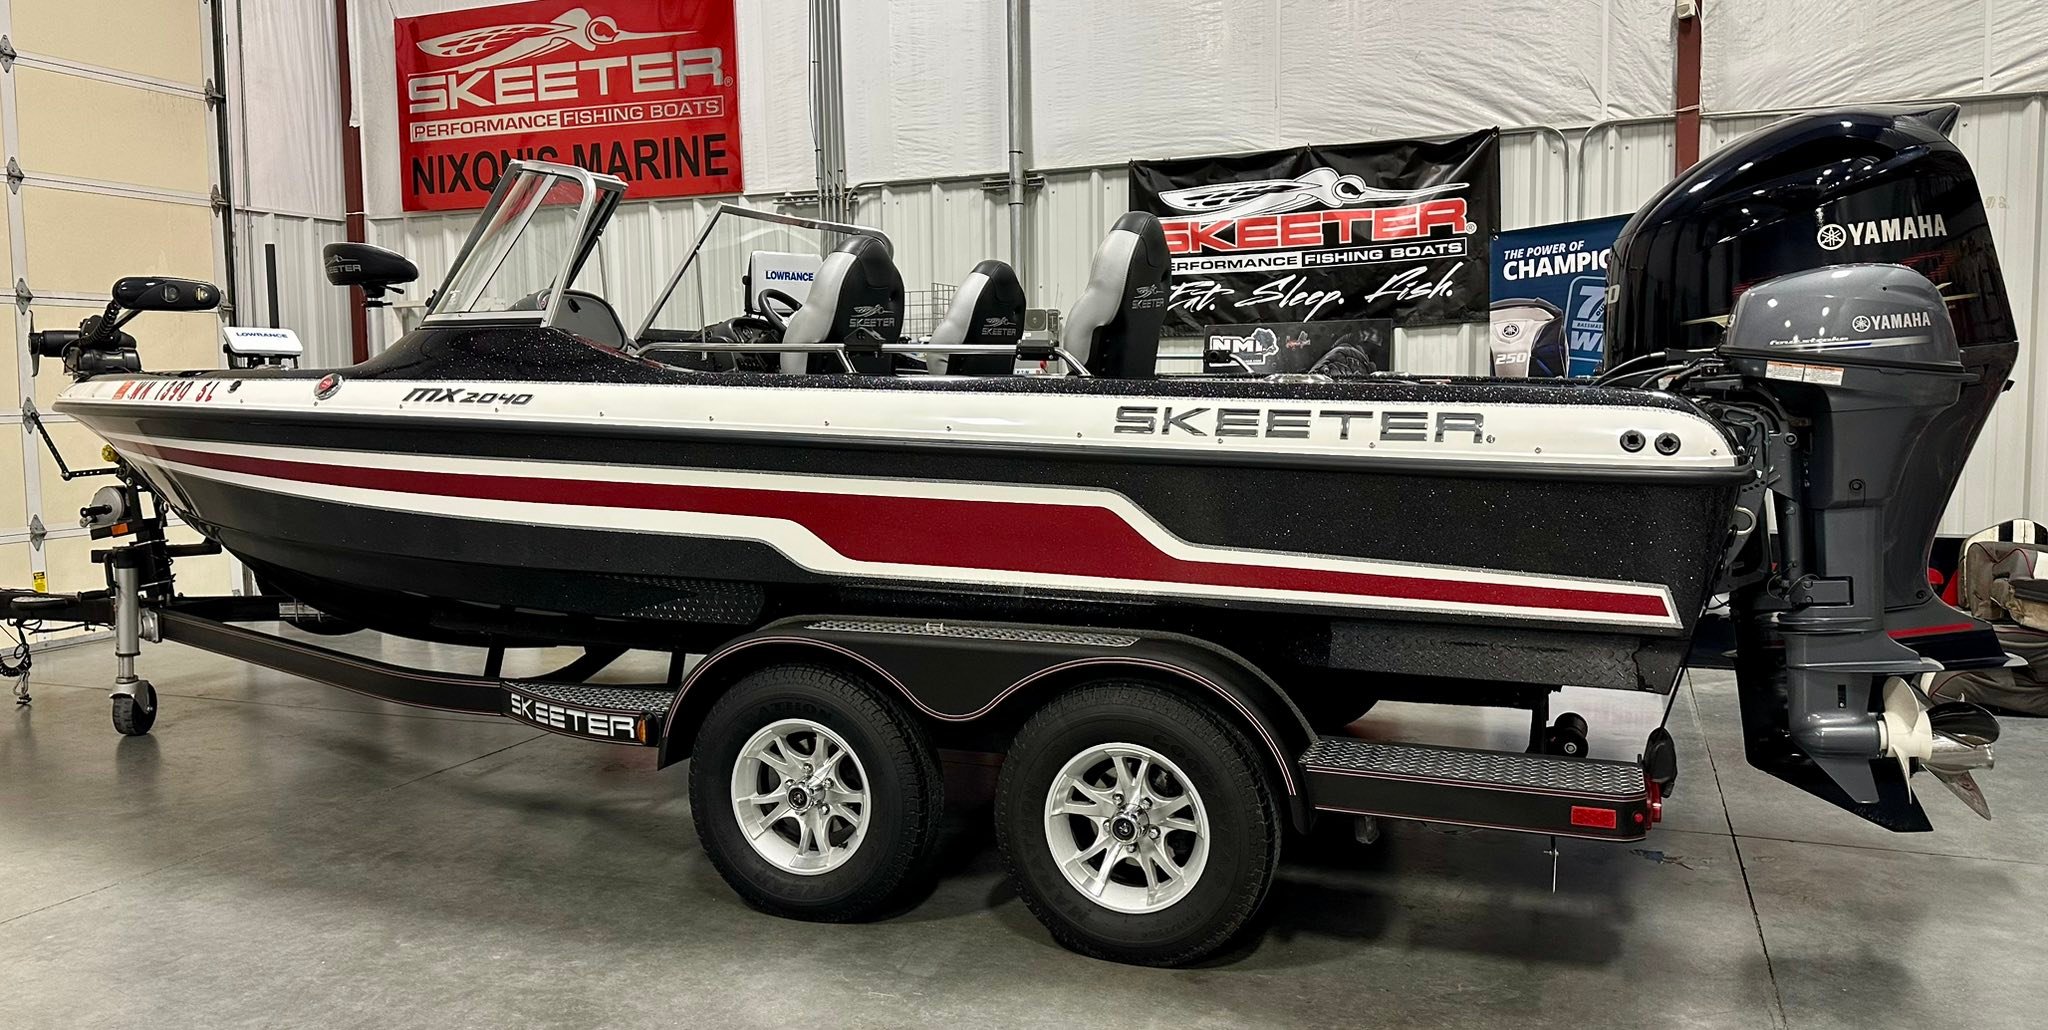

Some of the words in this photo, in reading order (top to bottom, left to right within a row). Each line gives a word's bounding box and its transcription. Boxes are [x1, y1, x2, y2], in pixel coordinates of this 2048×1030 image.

[409, 47, 725, 114] SKEETER
[414, 114, 558, 138] PERFORMANCE
[563, 106, 644, 126] FISHING
[650, 100, 720, 119] BOATS
[572, 133, 729, 182] MARINE
[1160, 198, 1467, 255] SKEETER
[1848, 214, 1948, 246] YAMAHA
[1171, 256, 1298, 272] ERFORMANCE
[1305, 249, 1383, 265] FISHING
[1390, 242, 1463, 259] BOATS
[1504, 249, 1524, 261] THE
[1526, 242, 1566, 258] POWER
[1569, 240, 1585, 252] OF
[765, 270, 814, 282] LOWRANCE
[1132, 298, 1164, 309] SKEETER
[849, 317, 895, 328] SKEETER
[981, 327, 1017, 336] SKEETER
[1871, 312, 1931, 331] YAMAHA
[236, 331, 288, 339] LOWRANCE
[1495, 352, 1528, 366] 250
[1114, 405, 1484, 444] SKEETER
[511, 692, 635, 739] SKEETER
